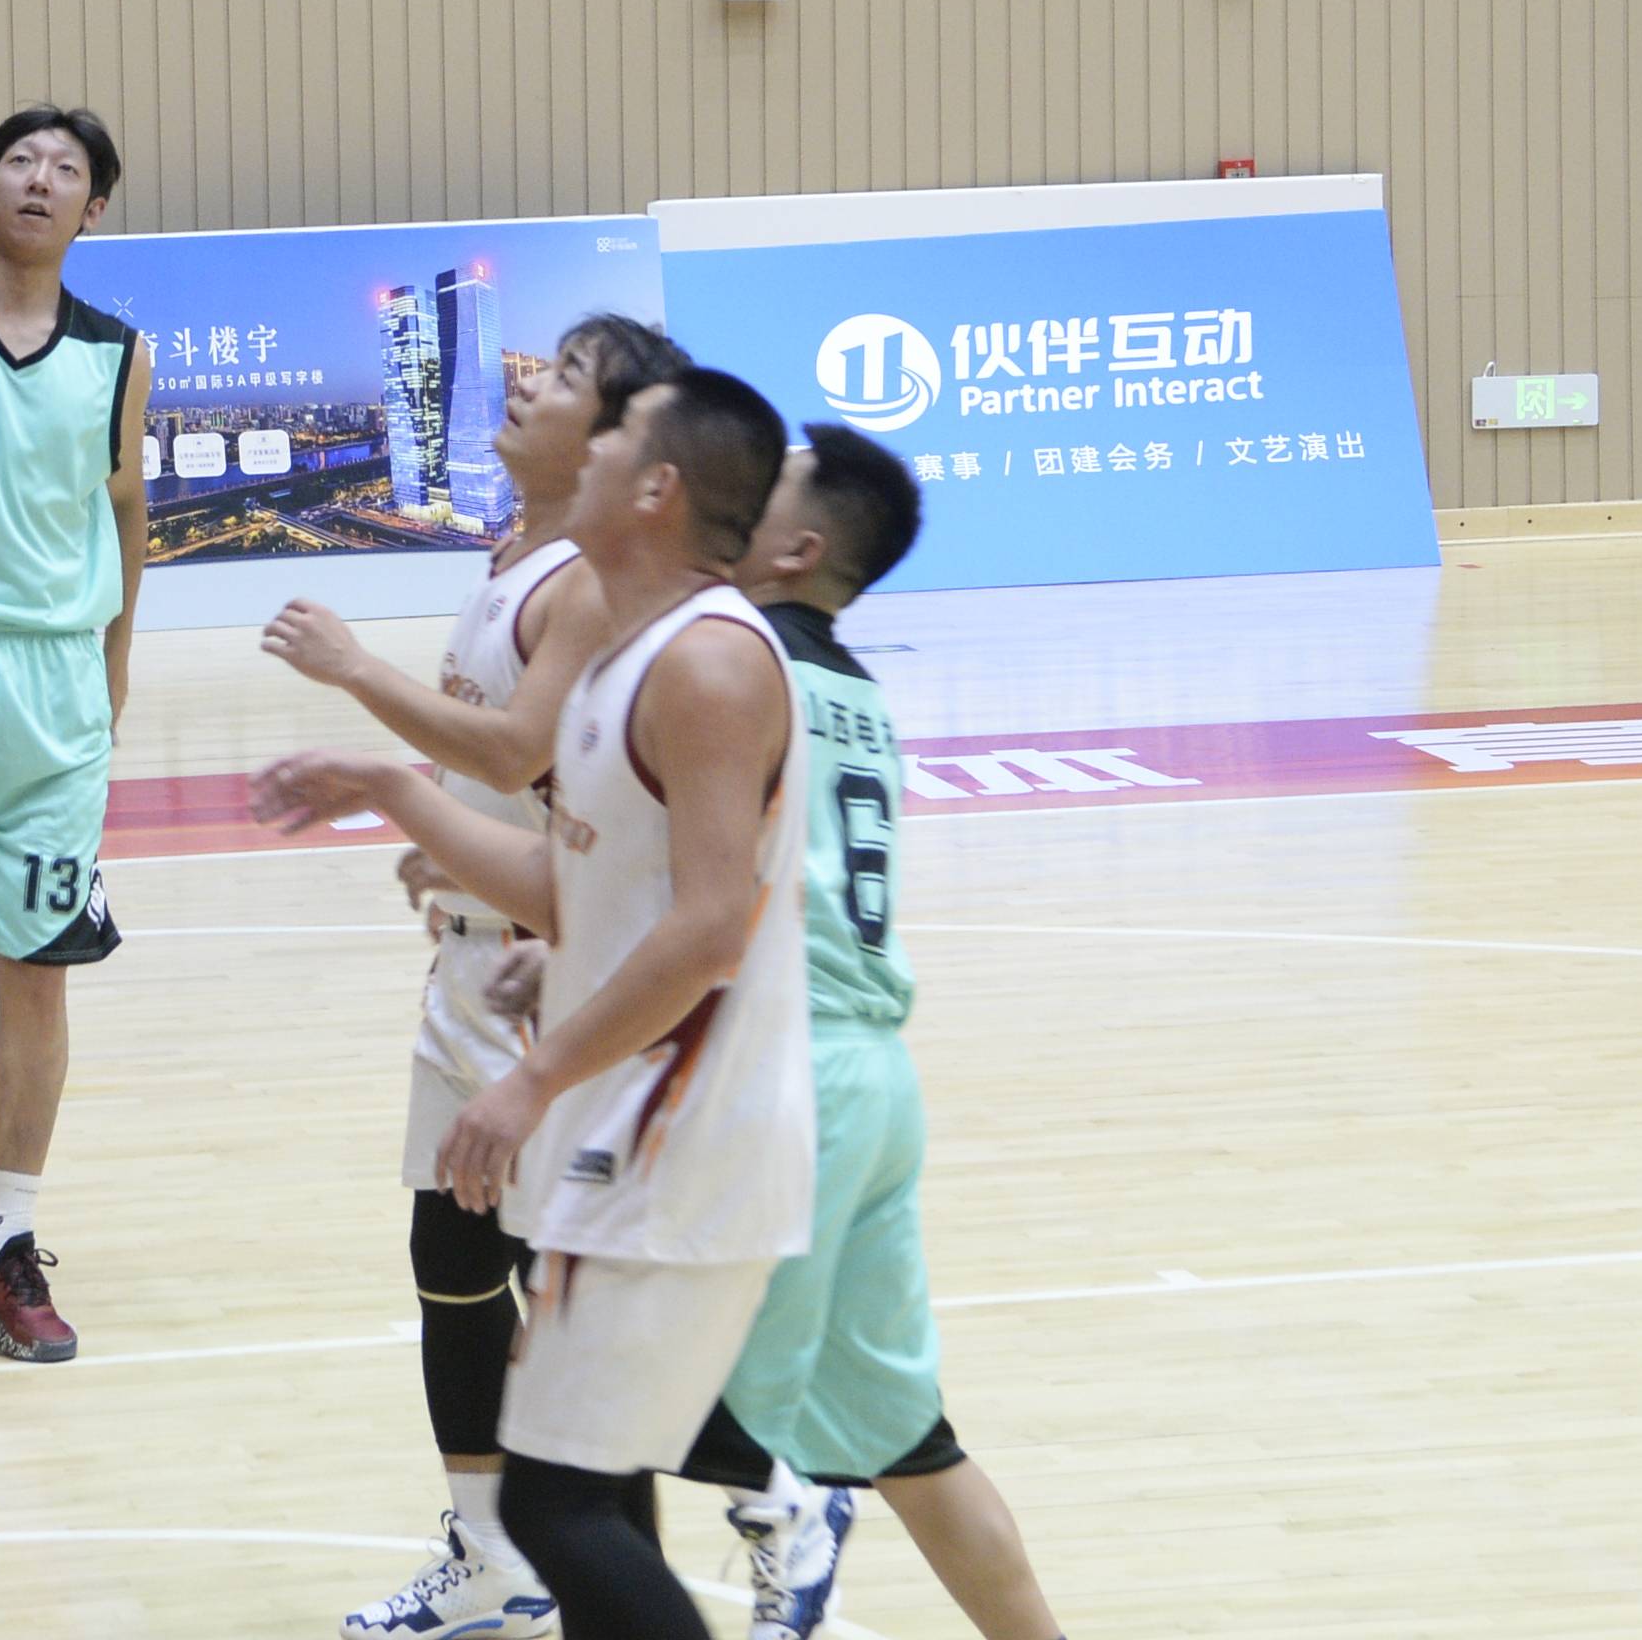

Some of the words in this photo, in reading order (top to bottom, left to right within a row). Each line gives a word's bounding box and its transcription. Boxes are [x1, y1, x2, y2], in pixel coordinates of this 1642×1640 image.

[950, 308, 1254, 381] 伙伴互动
[960, 384, 1102, 417] Partner
[1114, 370, 1265, 408] Interact
[900, 449, 983, 483] 赛事
[1034, 441, 1175, 477] 团建会务
[1223, 430, 1367, 466] 文艺演出
[21, 855, 80, 914] 13
[835, 762, 897, 958] 6
